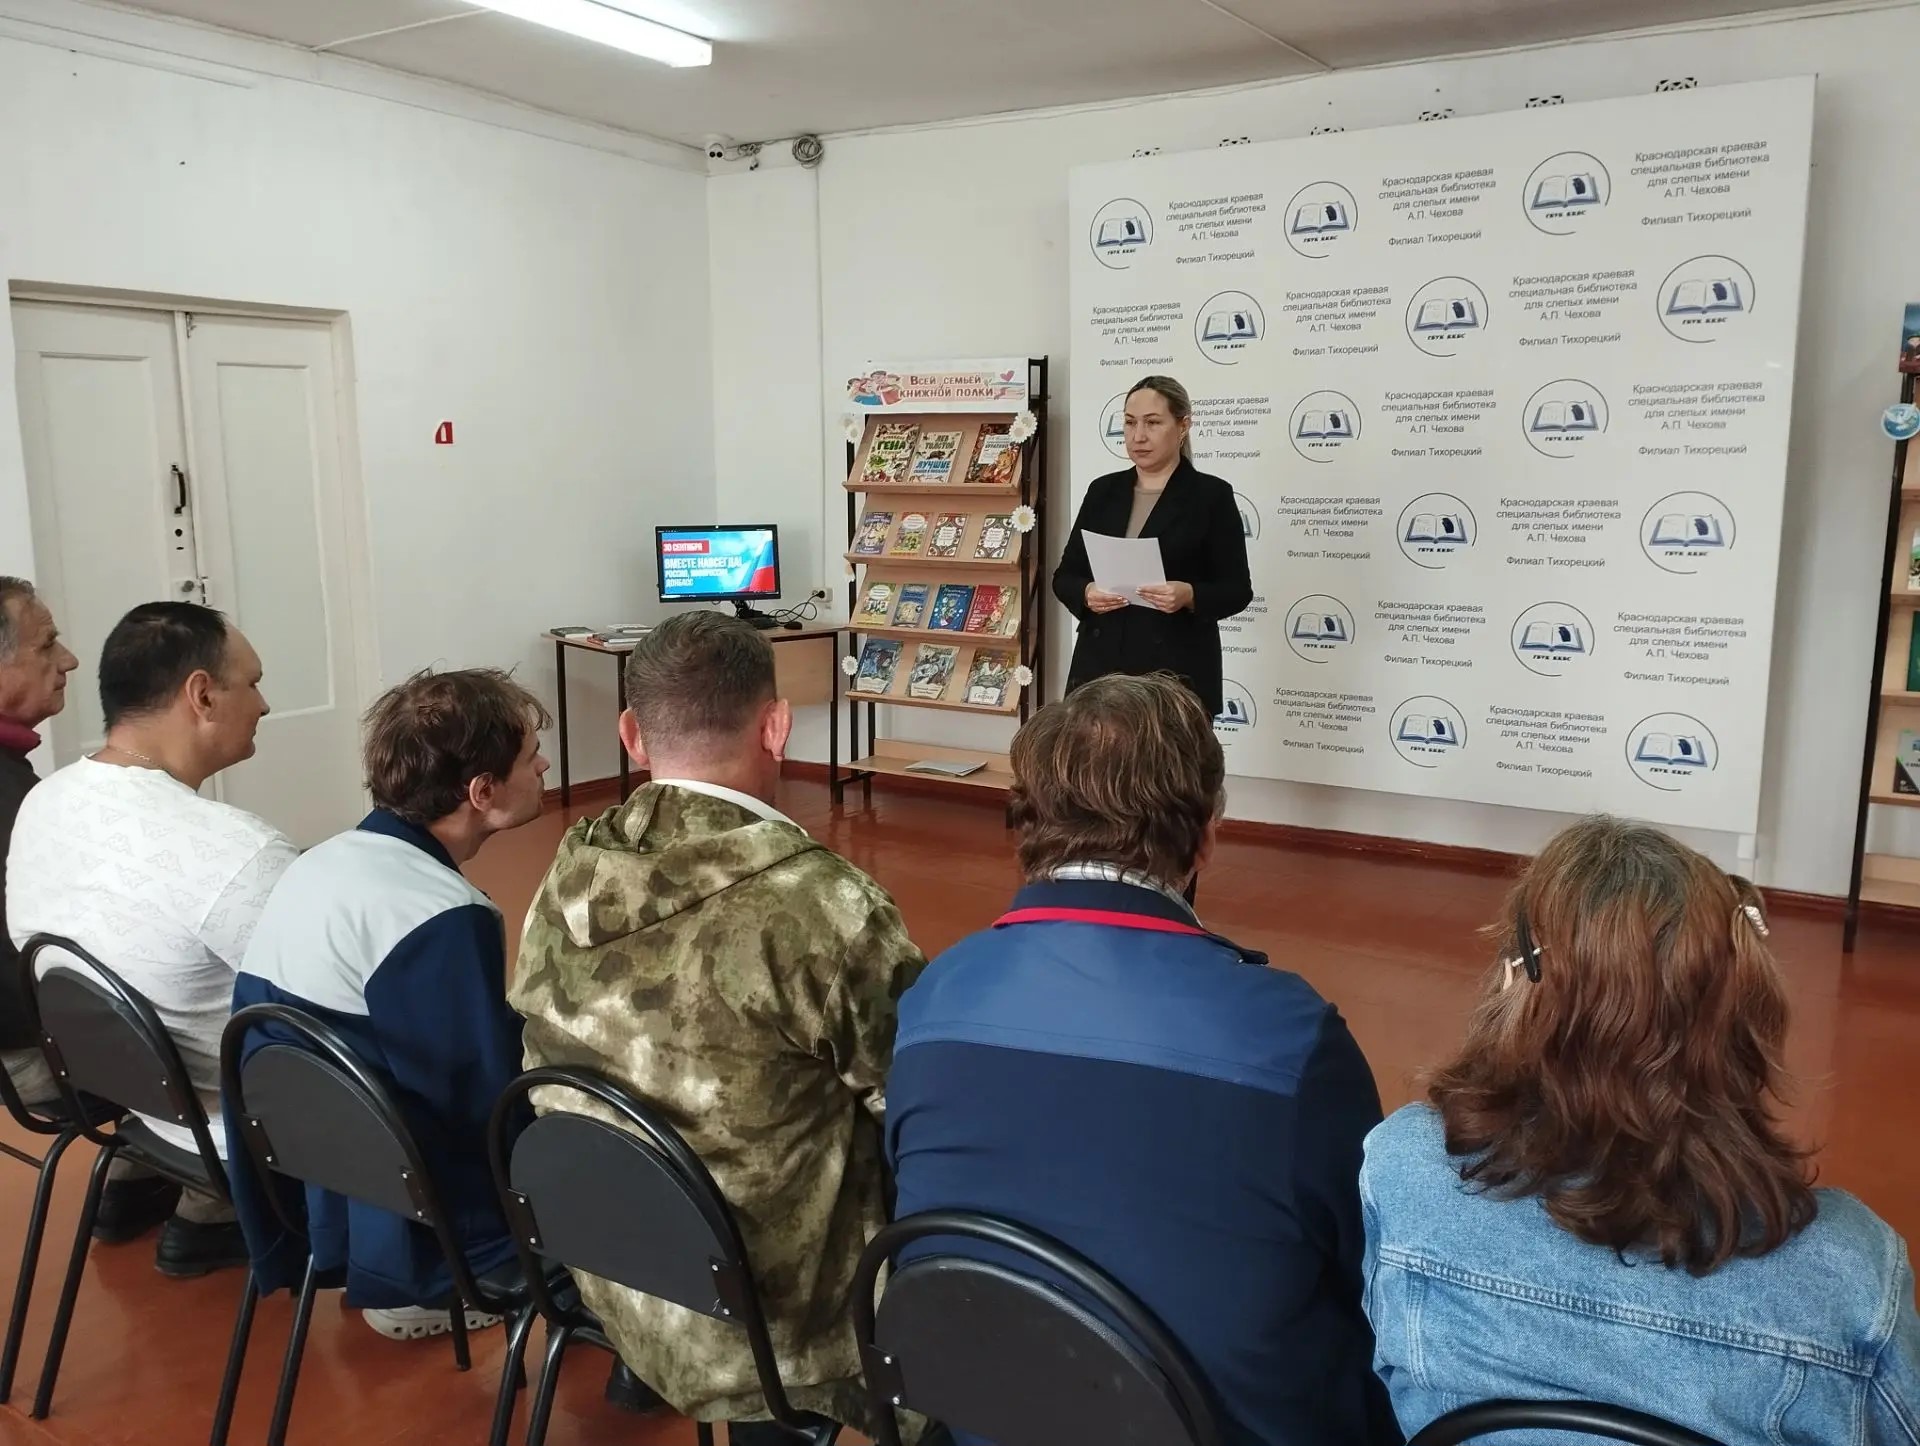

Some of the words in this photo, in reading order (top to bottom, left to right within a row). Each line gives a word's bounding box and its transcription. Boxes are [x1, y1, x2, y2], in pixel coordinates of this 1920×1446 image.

[1635, 146, 1718, 163] Краснодарская
[1721, 141, 1767, 154] краевая
[1630, 161, 1702, 175] специальная
[1704, 154, 1769, 168] библиотека
[1382, 173, 1452, 187] Краснодарская
[1454, 168, 1493, 180] краевая
[1647, 178, 1667, 188] для
[1670, 173, 1711, 184] слепых
[1714, 170, 1749, 180] имени
[1378, 186, 1438, 199] специальная
[1441, 180, 1496, 193] библиотека
[1690, 184, 1730, 195] Чехова
[1393, 201, 1410, 211] для
[1412, 198, 1447, 208] слепых
[1449, 195, 1479, 204] имени
[1429, 208, 1463, 218] Чехова
[1641, 215, 1683, 225] Филиал
[1687, 208, 1751, 221] Тихорецкий
[1388, 236, 1424, 245] Филиал
[1427, 230, 1481, 242] Тихорецкий
[1513, 273, 1589, 286] Краснодарская
[1592, 269, 1634, 281] краевая
[1286, 289, 1350, 301] Краснодарская
[1353, 286, 1388, 296] краевая
[1508, 286, 1574, 298] специальная
[1577, 282, 1637, 293] библиотека
[1283, 301, 1338, 311] специальная
[1340, 298, 1391, 308] библиотека
[1524, 301, 1543, 310] для
[1545, 298, 1583, 308] слепых
[1586, 296, 1619, 305] имени
[1295, 315, 1312, 323] для
[1314, 312, 1346, 321] слепых
[1348, 311, 1376, 319] имени
[1564, 310, 1601, 319] Чехова
[1330, 323, 1361, 331] Чехова
[1519, 337, 1558, 346] Филиал
[1561, 332, 1621, 344] Тихорецкий
[1292, 347, 1326, 355] Филиал
[1329, 344, 1378, 355] Тихорецкий
[1385, 391, 1453, 401] Краснодарская
[1456, 389, 1493, 399] краевая
[1381, 403, 1440, 411] специальная
[1442, 400, 1496, 410] библиотека
[1395, 415, 1412, 423] для
[1414, 414, 1448, 422] слепых
[1431, 424, 1464, 432] Чехова
[1391, 448, 1426, 456] Филиал
[1428, 447, 1482, 457] Тихорецкий
[1280, 495, 1343, 505] Краснодарская
[1345, 497, 1380, 505] краевая
[1500, 497, 1574, 508] Краснодарская
[1577, 499, 1618, 508] краевая
[1333, 506, 1383, 515] библиотека
[1562, 509, 1621, 519] библиотека
[1323, 528, 1353, 537] Чехова
[1511, 523, 1529, 531] для
[1550, 533, 1586, 542] Чехова
[1286, 550, 1319, 558] Филиал
[1322, 550, 1370, 560] Тихорецкий
[1506, 556, 1544, 565] Филиал
[1548, 557, 1605, 567] Тихорецкий
[1378, 600, 1444, 611] Краснодарская
[1374, 612, 1431, 621] специальная
[1433, 613, 1485, 623] библиотека
[1618, 612, 1697, 624] Краснодарская
[1700, 617, 1744, 625] краевая
[1441, 626, 1470, 634] имени
[1613, 625, 1681, 634] специальная
[1684, 626, 1746, 637] библиотека
[1422, 634, 1455, 644] Чехова
[1628, 637, 1649, 646] для
[1651, 638, 1690, 647] слепых
[1670, 649, 1709, 660] Чехова
[1384, 654, 1418, 663] Филиал
[1420, 656, 1472, 667] Тихорецкий
[1624, 671, 1664, 681] Филиал
[1667, 673, 1729, 685] Тихорецкий
[1490, 705, 1561, 718] Краснодарская
[1564, 712, 1604, 721] краевая
[1486, 717, 1547, 728] специальная
[1550, 721, 1607, 733] библиотека
[1521, 731, 1556, 741] слепых
[1559, 735, 1590, 743] имени
[1538, 742, 1573, 753] Чехова
[1496, 761, 1532, 771] Филиал
[1536, 764, 1592, 777] Тихорецкий
